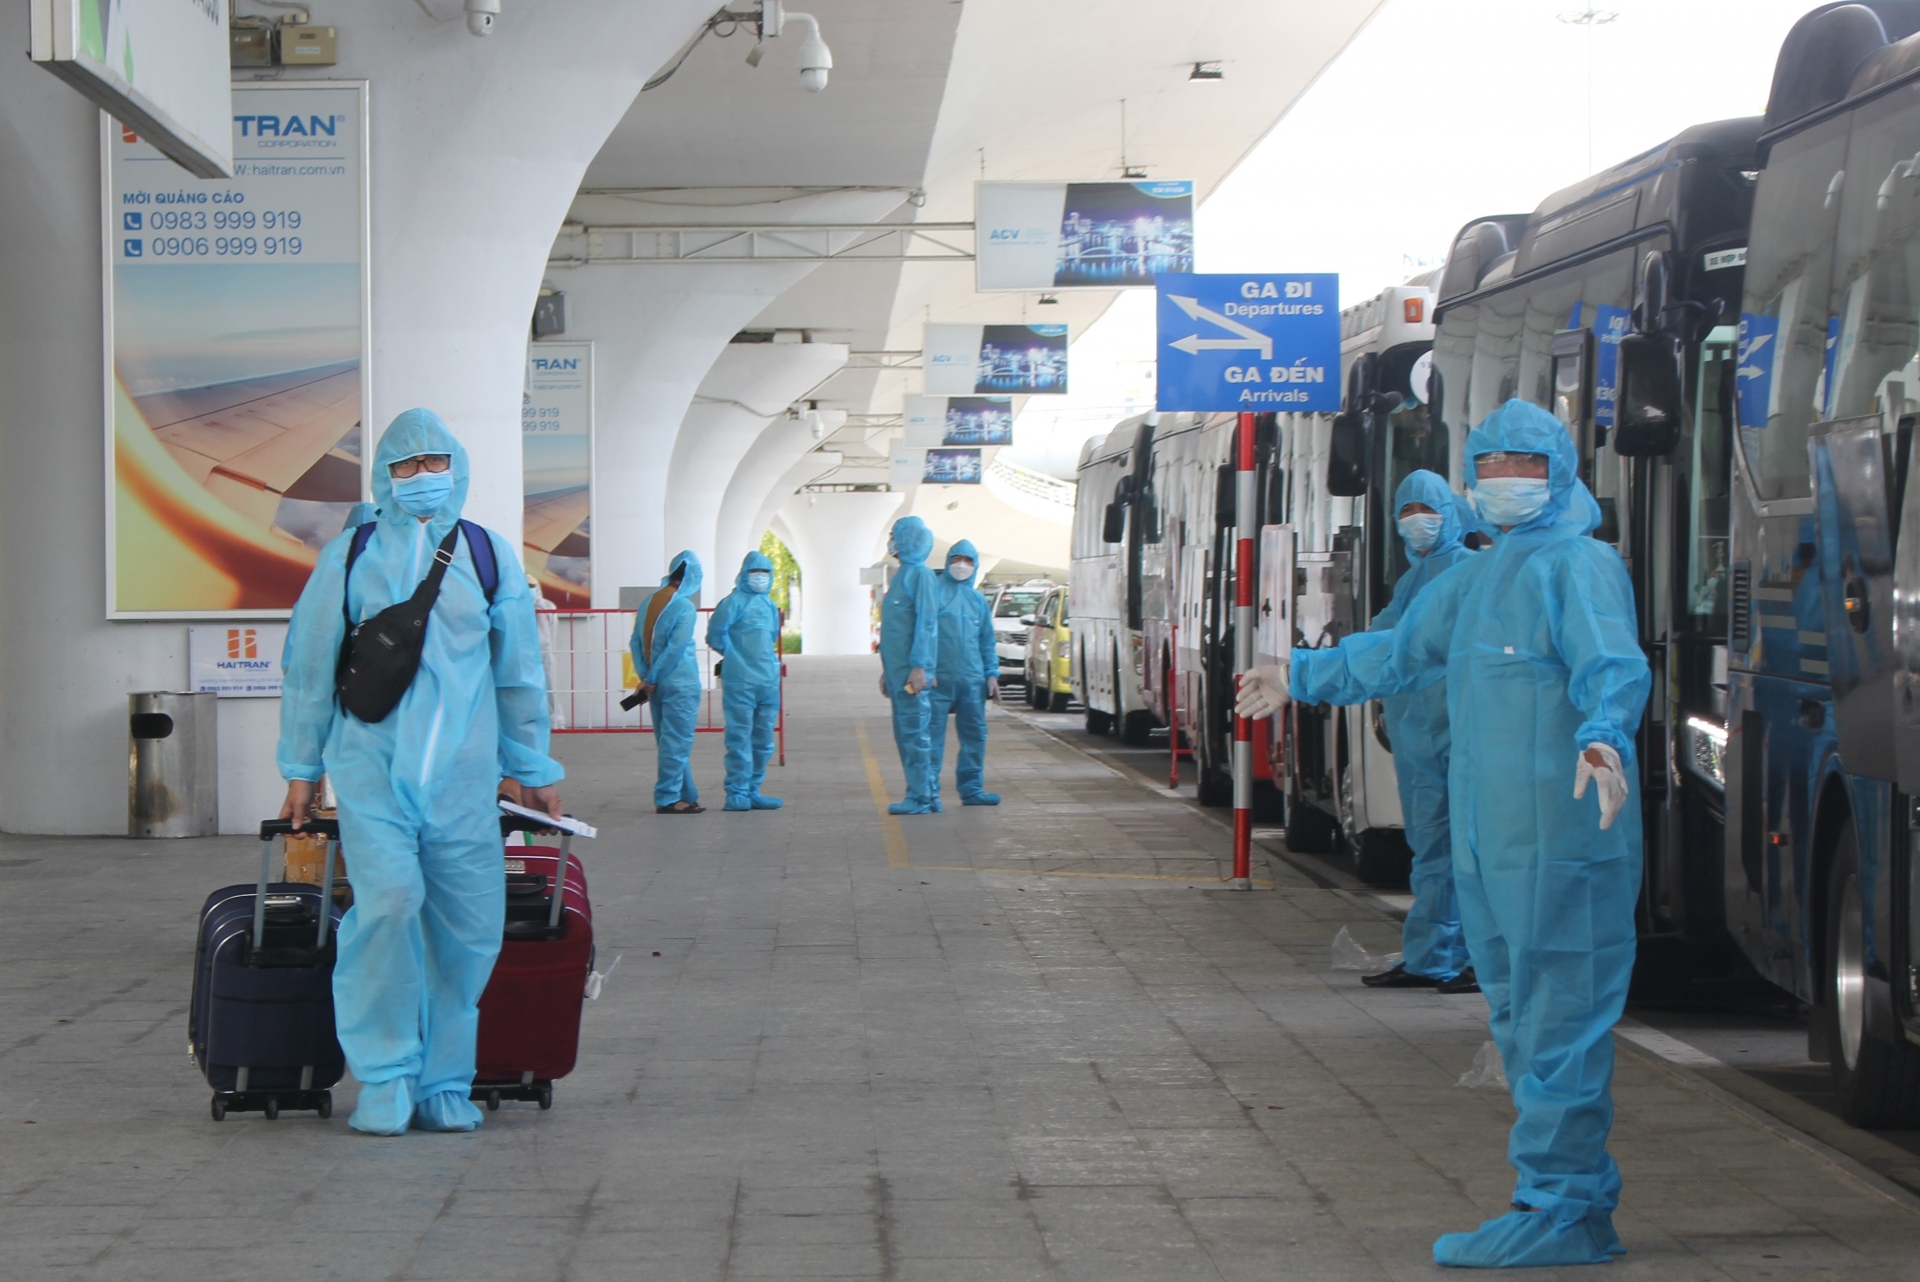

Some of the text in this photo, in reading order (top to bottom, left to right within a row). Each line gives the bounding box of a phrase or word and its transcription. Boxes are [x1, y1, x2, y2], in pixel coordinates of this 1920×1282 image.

[258, 140, 337, 148] CORPORATION
[252, 164, 345, 176] haitran.com.vn
[123, 188, 245, 204] MỜI QUẢNG CÁO
[150, 210, 301, 229] 0983 999 919
[990, 228, 1019, 240] ACV
[152, 236, 302, 255] 0906 999 919
[1240, 281, 1313, 299] GA ĐI
[1224, 302, 1324, 318] Departures
[532, 358, 578, 370] RAN
[1224, 357, 1325, 383] GA ĐẾN
[1238, 388, 1310, 403] Arrivals
[539, 407, 560, 418] 919
[539, 420, 560, 431] 919
